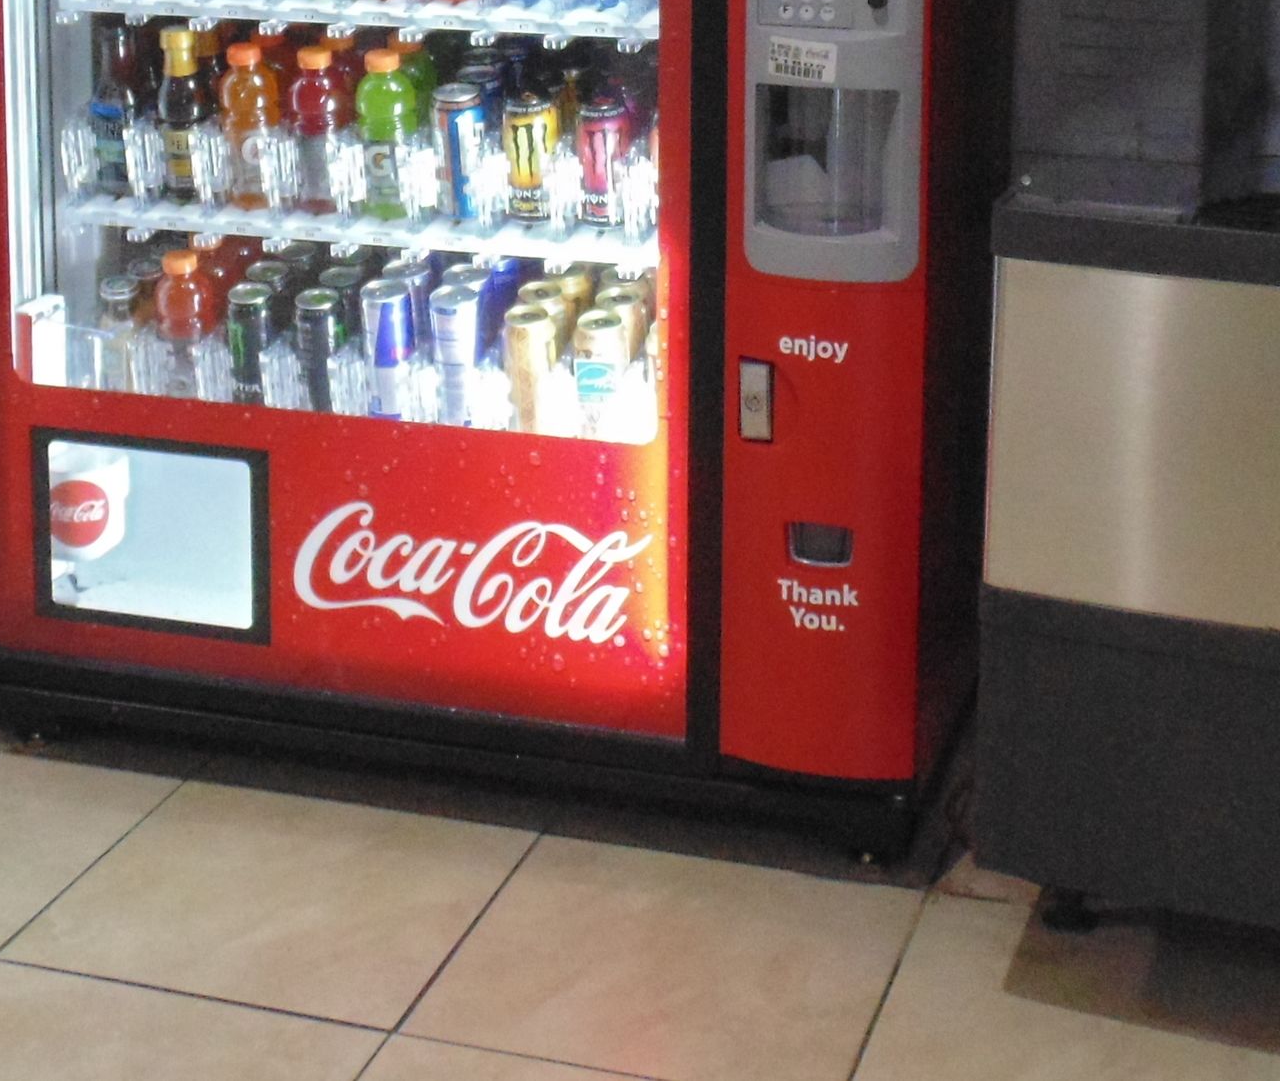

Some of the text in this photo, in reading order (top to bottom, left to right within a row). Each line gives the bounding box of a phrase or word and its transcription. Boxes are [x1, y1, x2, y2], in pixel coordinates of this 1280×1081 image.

[779, 336, 848, 363] enjoy
[293, 501, 652, 646] Coca-Cola
[777, 579, 859, 607] Thank
[789, 606, 846, 631] You.
